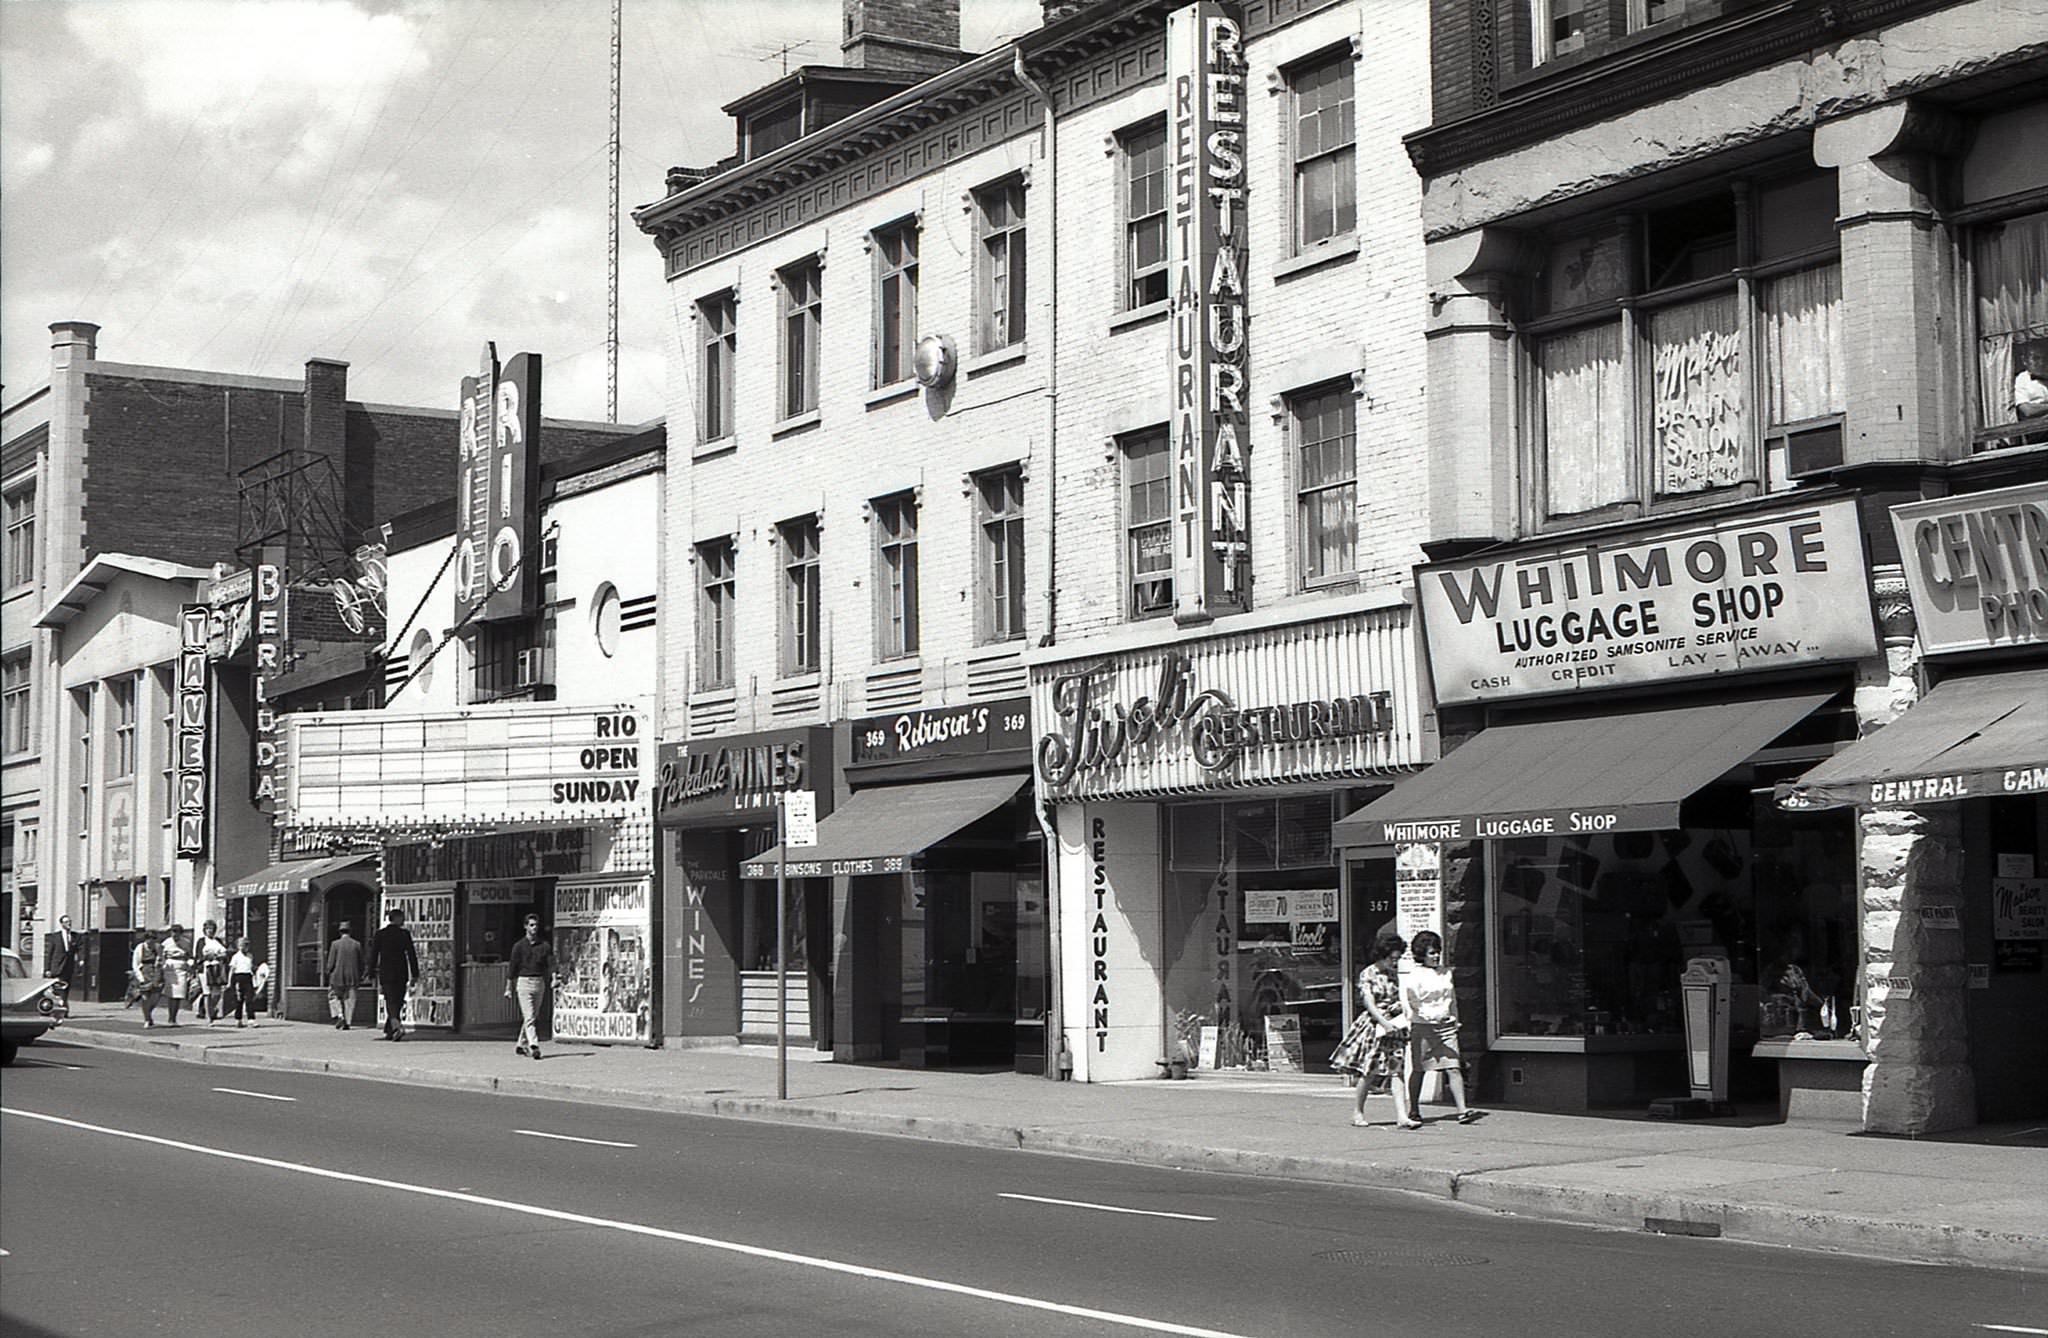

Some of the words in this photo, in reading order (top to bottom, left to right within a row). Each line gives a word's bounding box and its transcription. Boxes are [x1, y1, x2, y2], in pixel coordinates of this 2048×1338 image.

[1176, 75, 1194, 558] RESTAURANT
[1206, 16, 1247, 593] RESTAURANT
[457, 396, 477, 603] RIO
[489, 380, 521, 592] RIO
[1438, 513, 1828, 625] WHITMORE
[1496, 601, 1660, 654] LUGGAGE
[1692, 582, 1785, 629] SHOP
[1514, 648, 1599, 669] AUTHORIZED
[1607, 637, 1686, 659] SAMSONITE
[1695, 627, 1759, 647] SERVICE
[1471, 676, 1512, 690] CASH
[1551, 663, 1617, 682] CREDIT
[1668, 652, 1708, 668] LAY
[181, 612, 207, 849] TAVERN
[597, 715, 636, 738] RIO
[866, 730, 886, 748] 369
[895, 707, 990, 752] Robinson's
[1003, 714, 1026, 731] 369
[1038, 650, 1222, 787] Tivoli
[1203, 690, 1393, 751] RESTAURANT
[580, 747, 638, 770] OPEN
[677, 746, 689, 757] THE
[553, 780, 640, 804] SUNDAY
[657, 746, 729, 812] Parkdale
[728, 740, 804, 790] WINES
[1871, 776, 1968, 802] CENTRAL
[735, 791, 783, 810] LIMIT
[1384, 820, 1461, 841] WHITMORE
[1476, 817, 1554, 837] LUGGAGE
[1570, 812, 1617, 831] SHOP
[747, 864, 764, 876] 369
[774, 862, 822, 876] RBINSONS
[832, 860, 873, 874] CLOTHES
[883, 858, 903, 872] 369
[419, 898, 452, 922] LADD
[556, 888, 590, 913] ROBERT
[593, 885, 645, 912] MITCHUM
[1369, 900, 1389, 912] 367
[686, 885, 707, 1003] WINES
[1092, 818, 1109, 1052] RESTAURANT
[1288, 923, 1327, 946] Tivoli
[554, 1014, 606, 1037] GANGSTER
[608, 1014, 633, 1037] MOB
